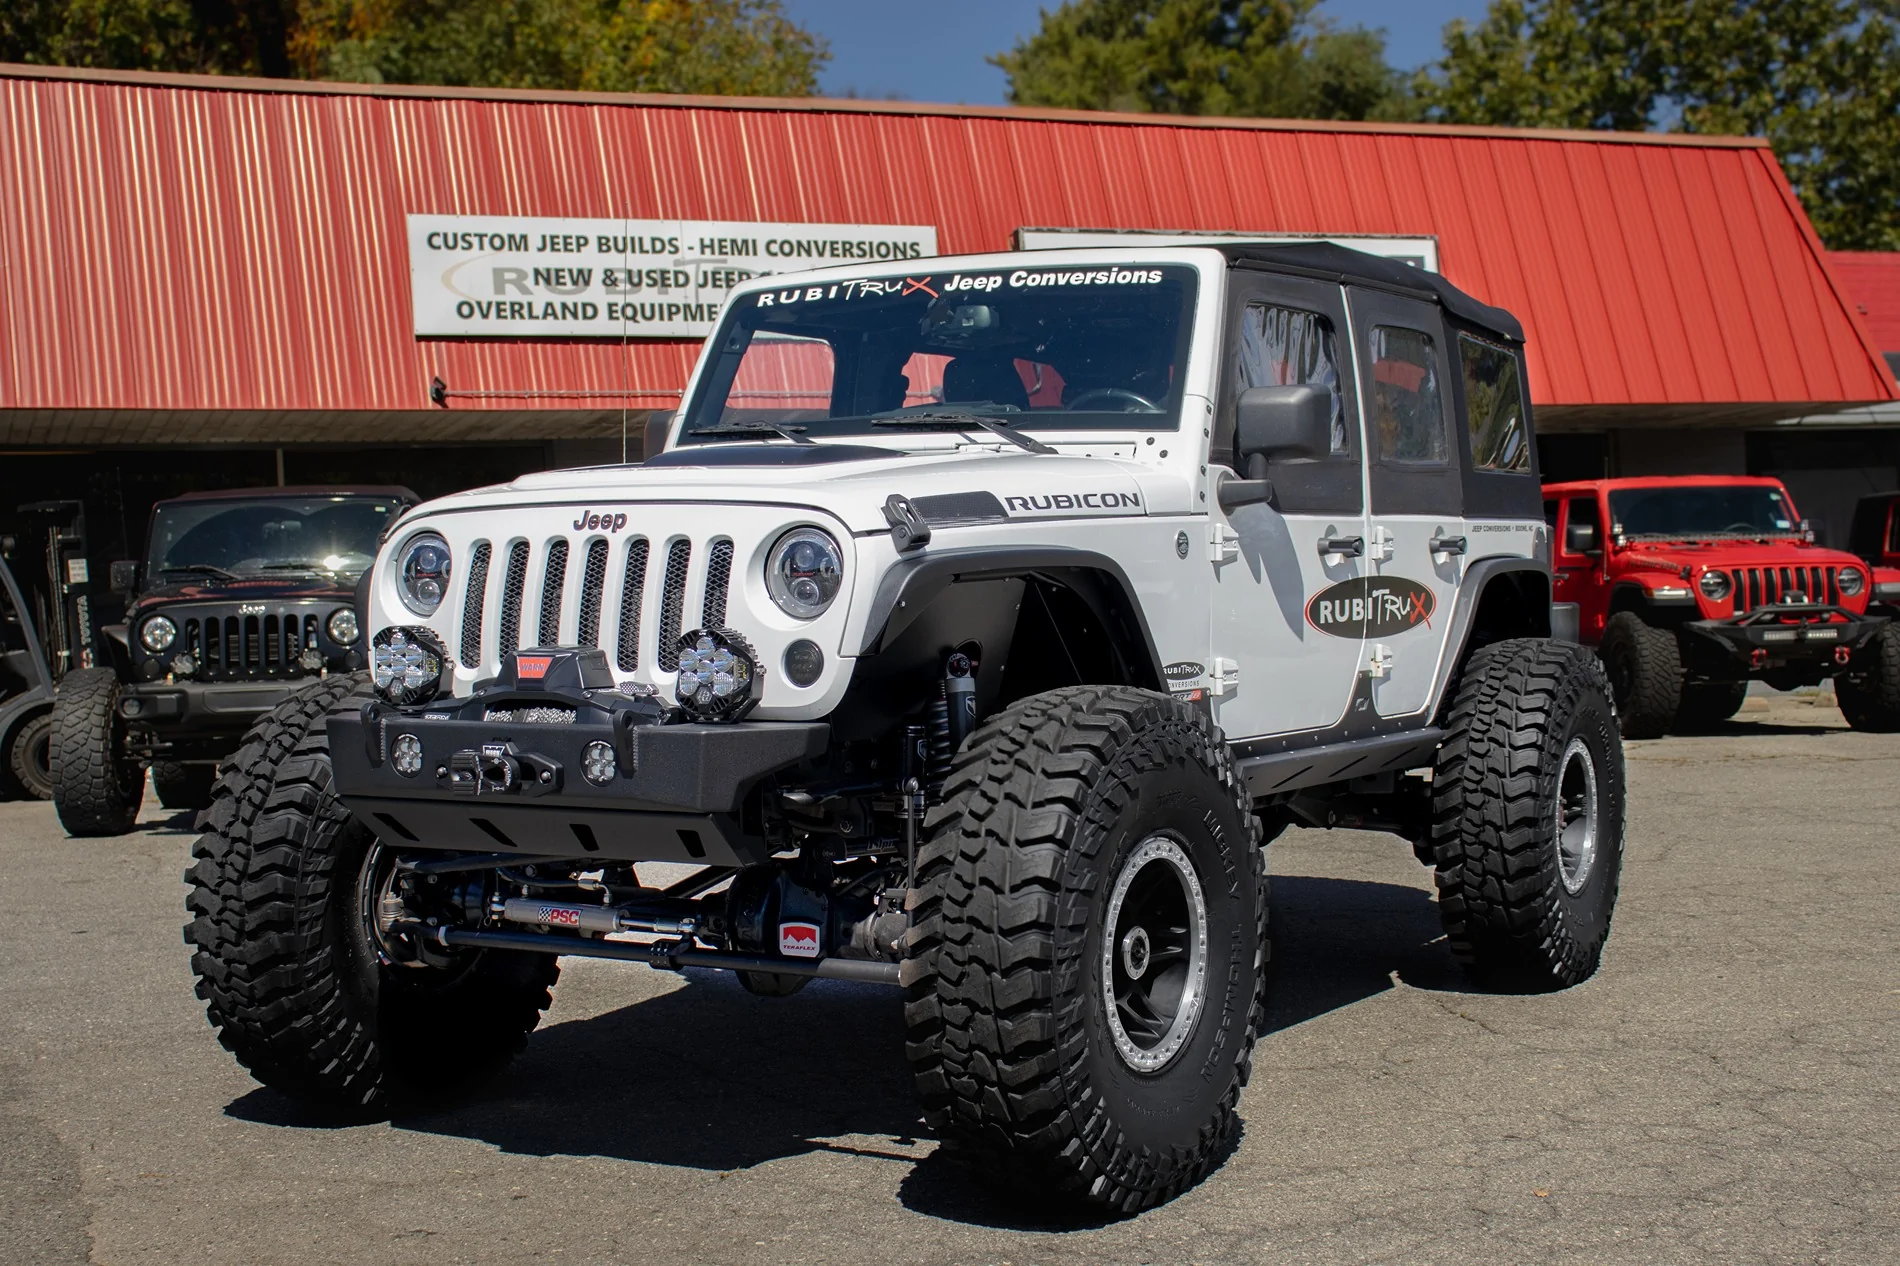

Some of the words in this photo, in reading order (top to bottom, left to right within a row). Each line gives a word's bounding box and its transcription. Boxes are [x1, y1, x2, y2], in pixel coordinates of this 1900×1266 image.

[427, 231, 529, 252] CUSTOM
[536, 234, 589, 253] JEEP
[597, 236, 680, 254] BUILDS
[699, 237, 758, 256] HEMI
[765, 239, 921, 259] CONVERSIONS
[532, 268, 593, 287] NEW
[602, 269, 619, 287] &
[627, 269, 690, 288] USED
[944, 274, 1003, 294] Jeep
[1009, 266, 1163, 288] Conversions
[456, 300, 600, 321] OVERLAND
[607, 302, 724, 324] EQUIPME
[1004, 493, 1140, 511] RUBICON
[573, 509, 628, 533] Jeep
[77, 595, 92, 645] TOYOTA
[238, 604, 266, 616] Jeep
[521, 663, 545, 671] WARN
[550, 908, 580, 925] PSC
